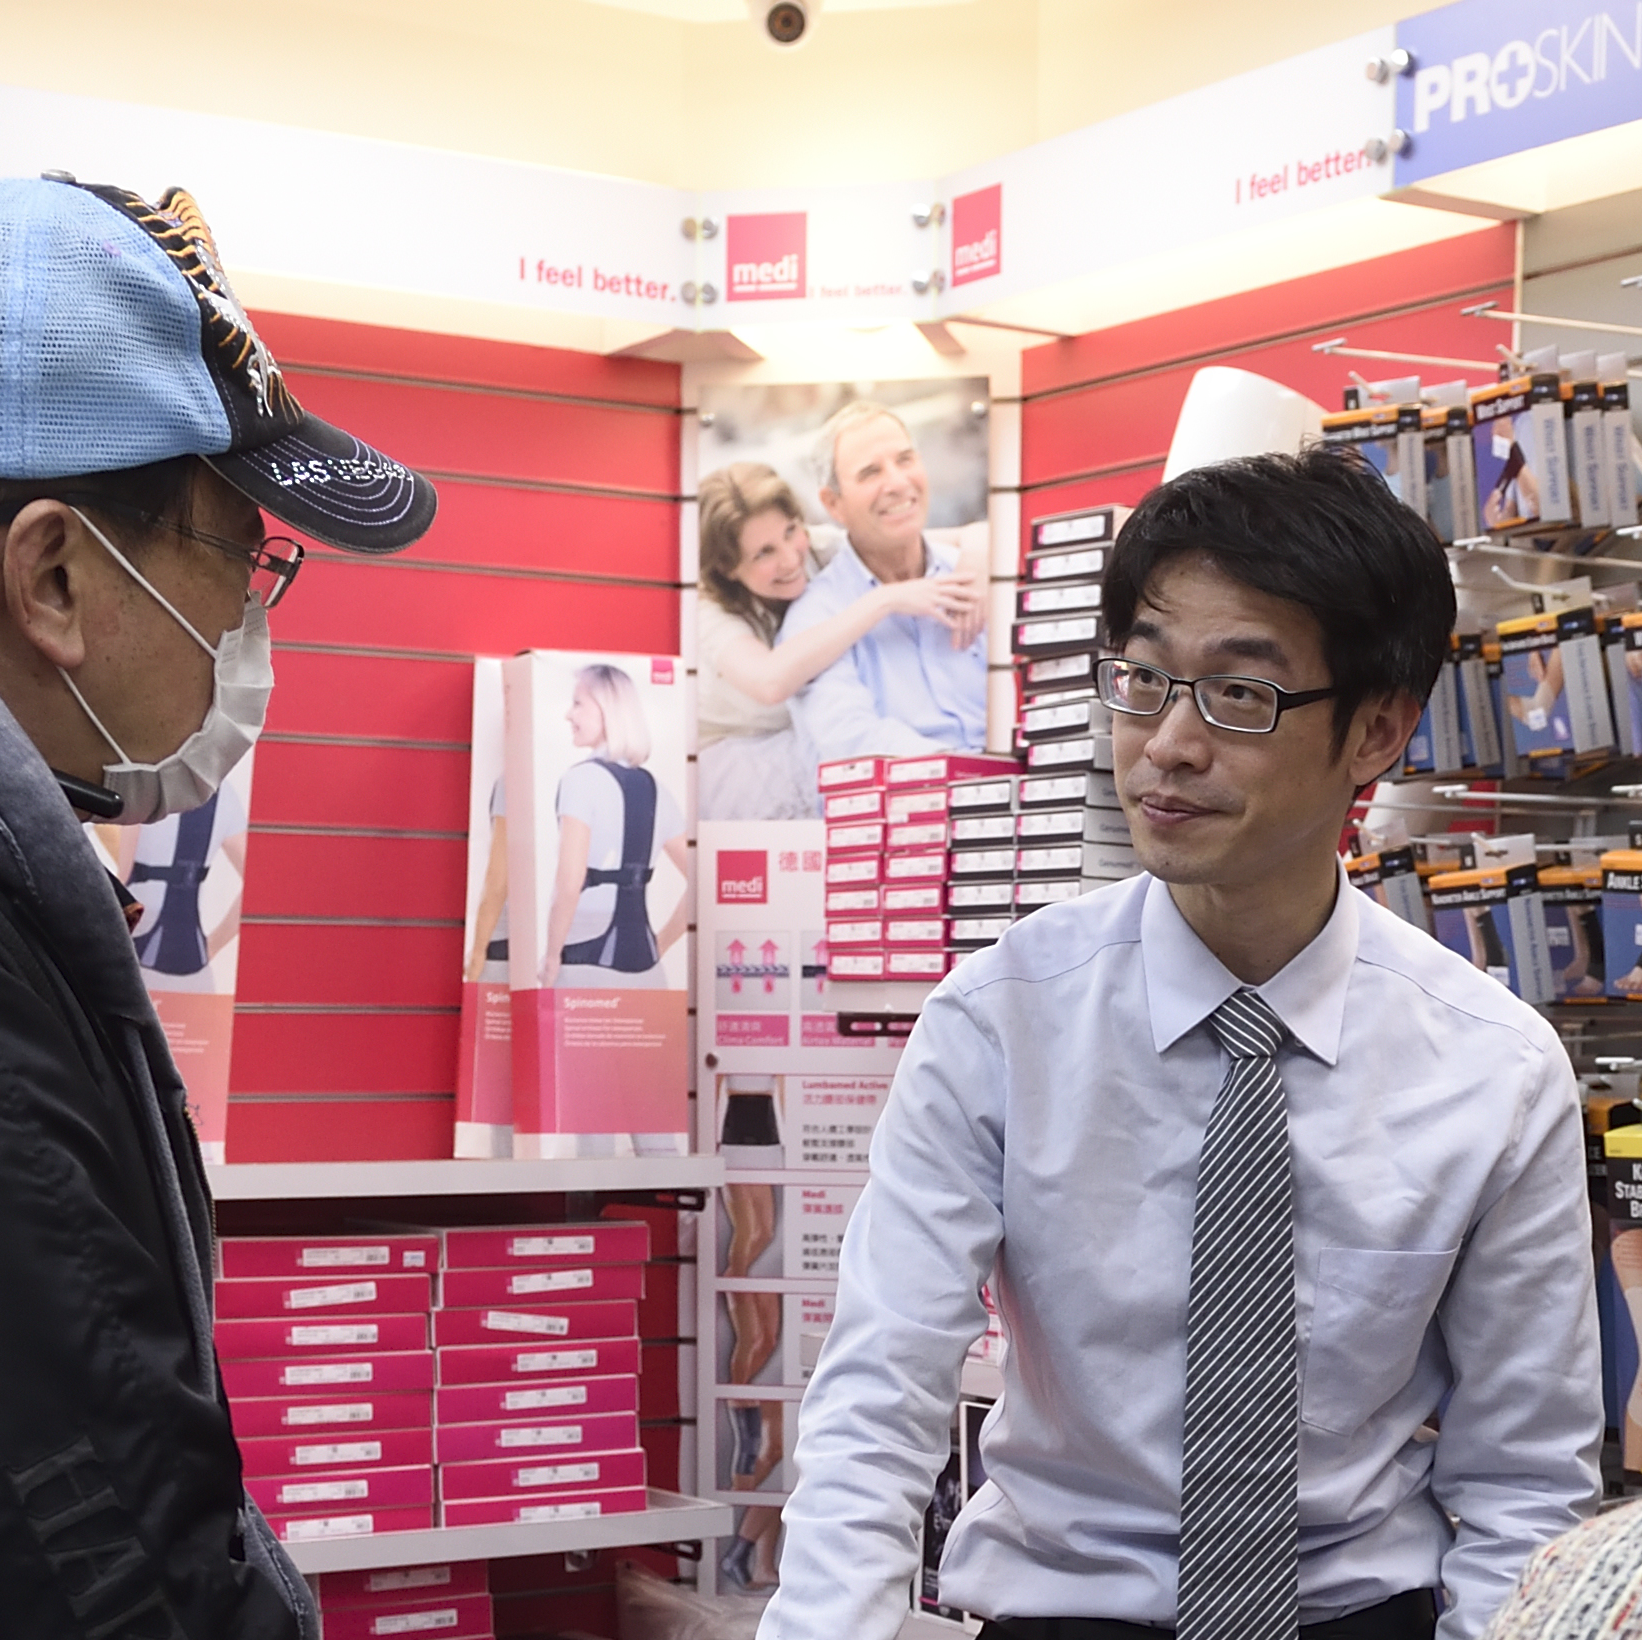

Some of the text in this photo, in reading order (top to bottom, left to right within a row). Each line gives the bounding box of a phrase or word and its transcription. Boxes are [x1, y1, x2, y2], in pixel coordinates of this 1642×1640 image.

[1235, 178, 1241, 205] I
[1249, 164, 1289, 201] feel
[954, 229, 997, 266] medi
[519, 257, 677, 301] I feel better.
[732, 253, 799, 283] medi
[271, 459, 331, 486] LAS
[1634, 833, 1642, 846] S
[721, 876, 763, 893] medi
[1607, 872, 1639, 891] ANKLE
[745, 1035, 785, 1045] Comfort
[802, 1189, 826, 1200] Medi
